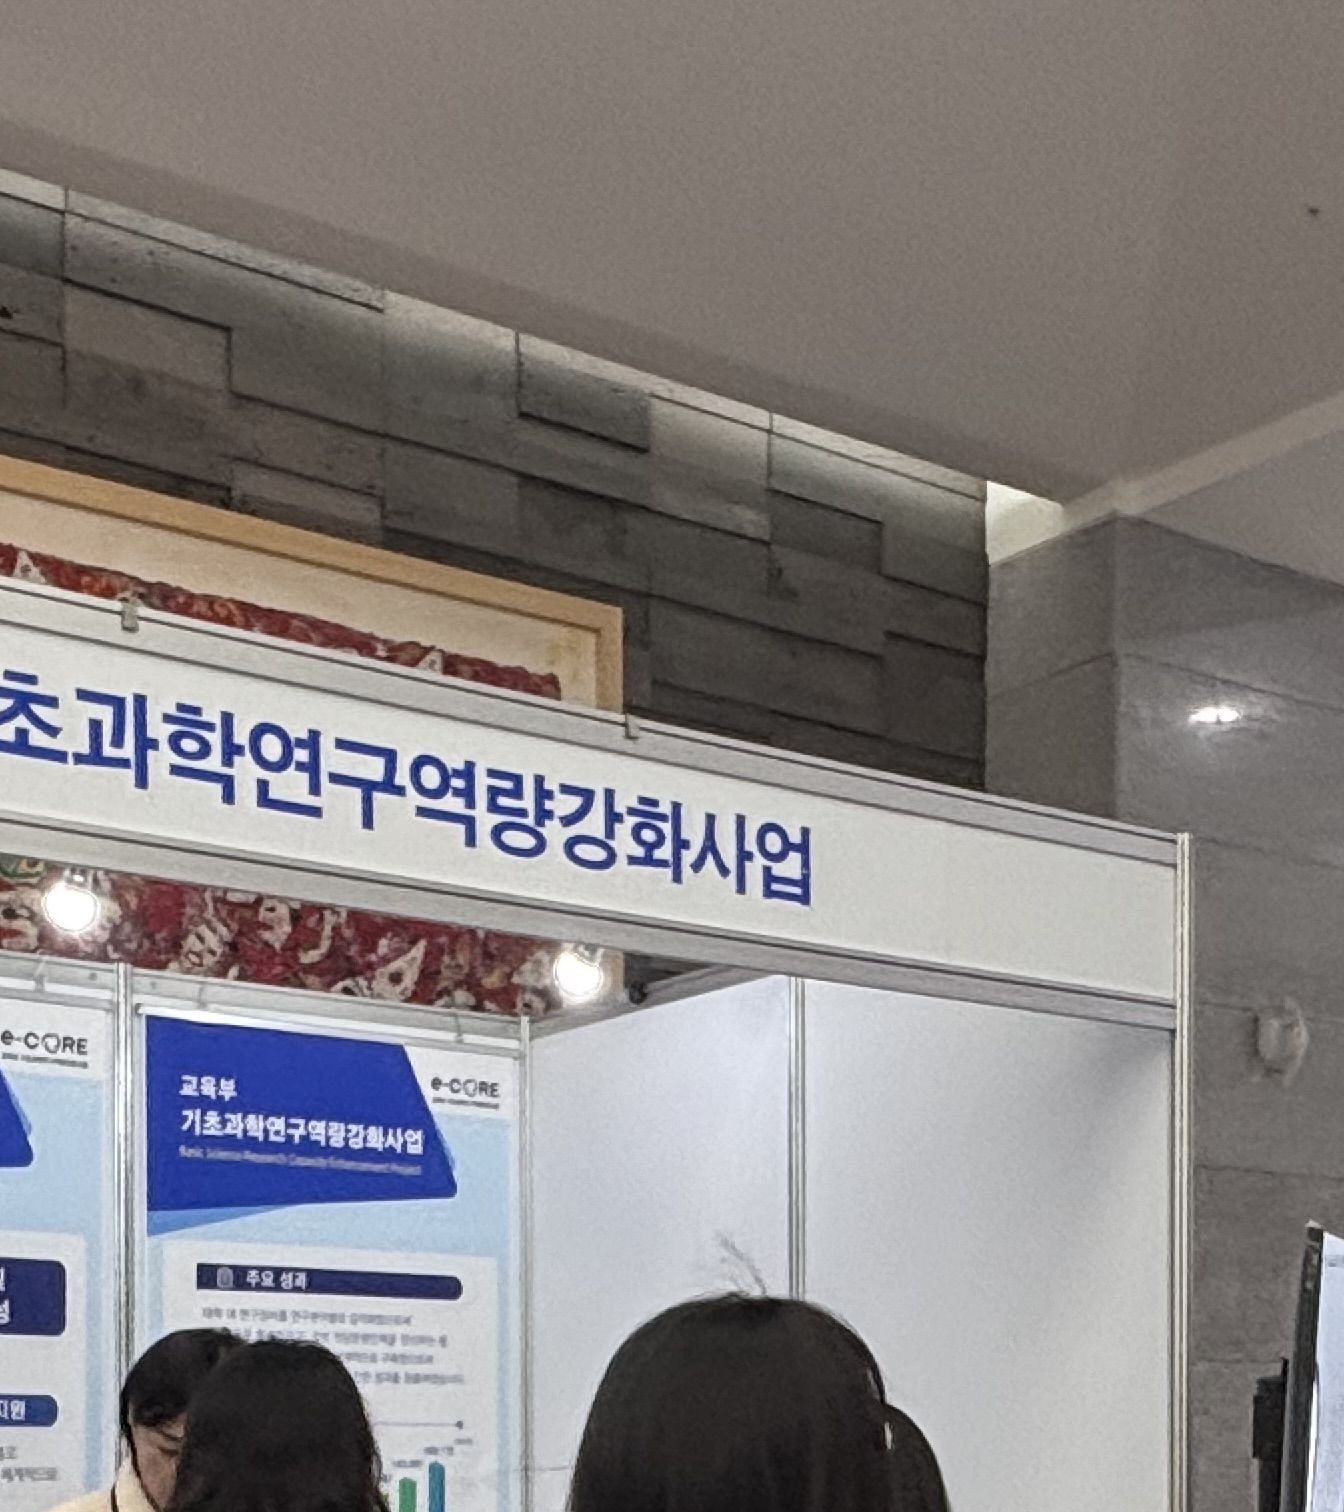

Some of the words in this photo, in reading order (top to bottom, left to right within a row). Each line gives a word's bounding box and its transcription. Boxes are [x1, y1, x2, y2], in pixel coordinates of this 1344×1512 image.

[179, 1074, 238, 1101] 교육부
[181, 1108, 424, 1155] 기초과학연구역량강화사업
[246, 1270, 274, 1287] 주요
[280, 1271, 306, 1290] 성과
